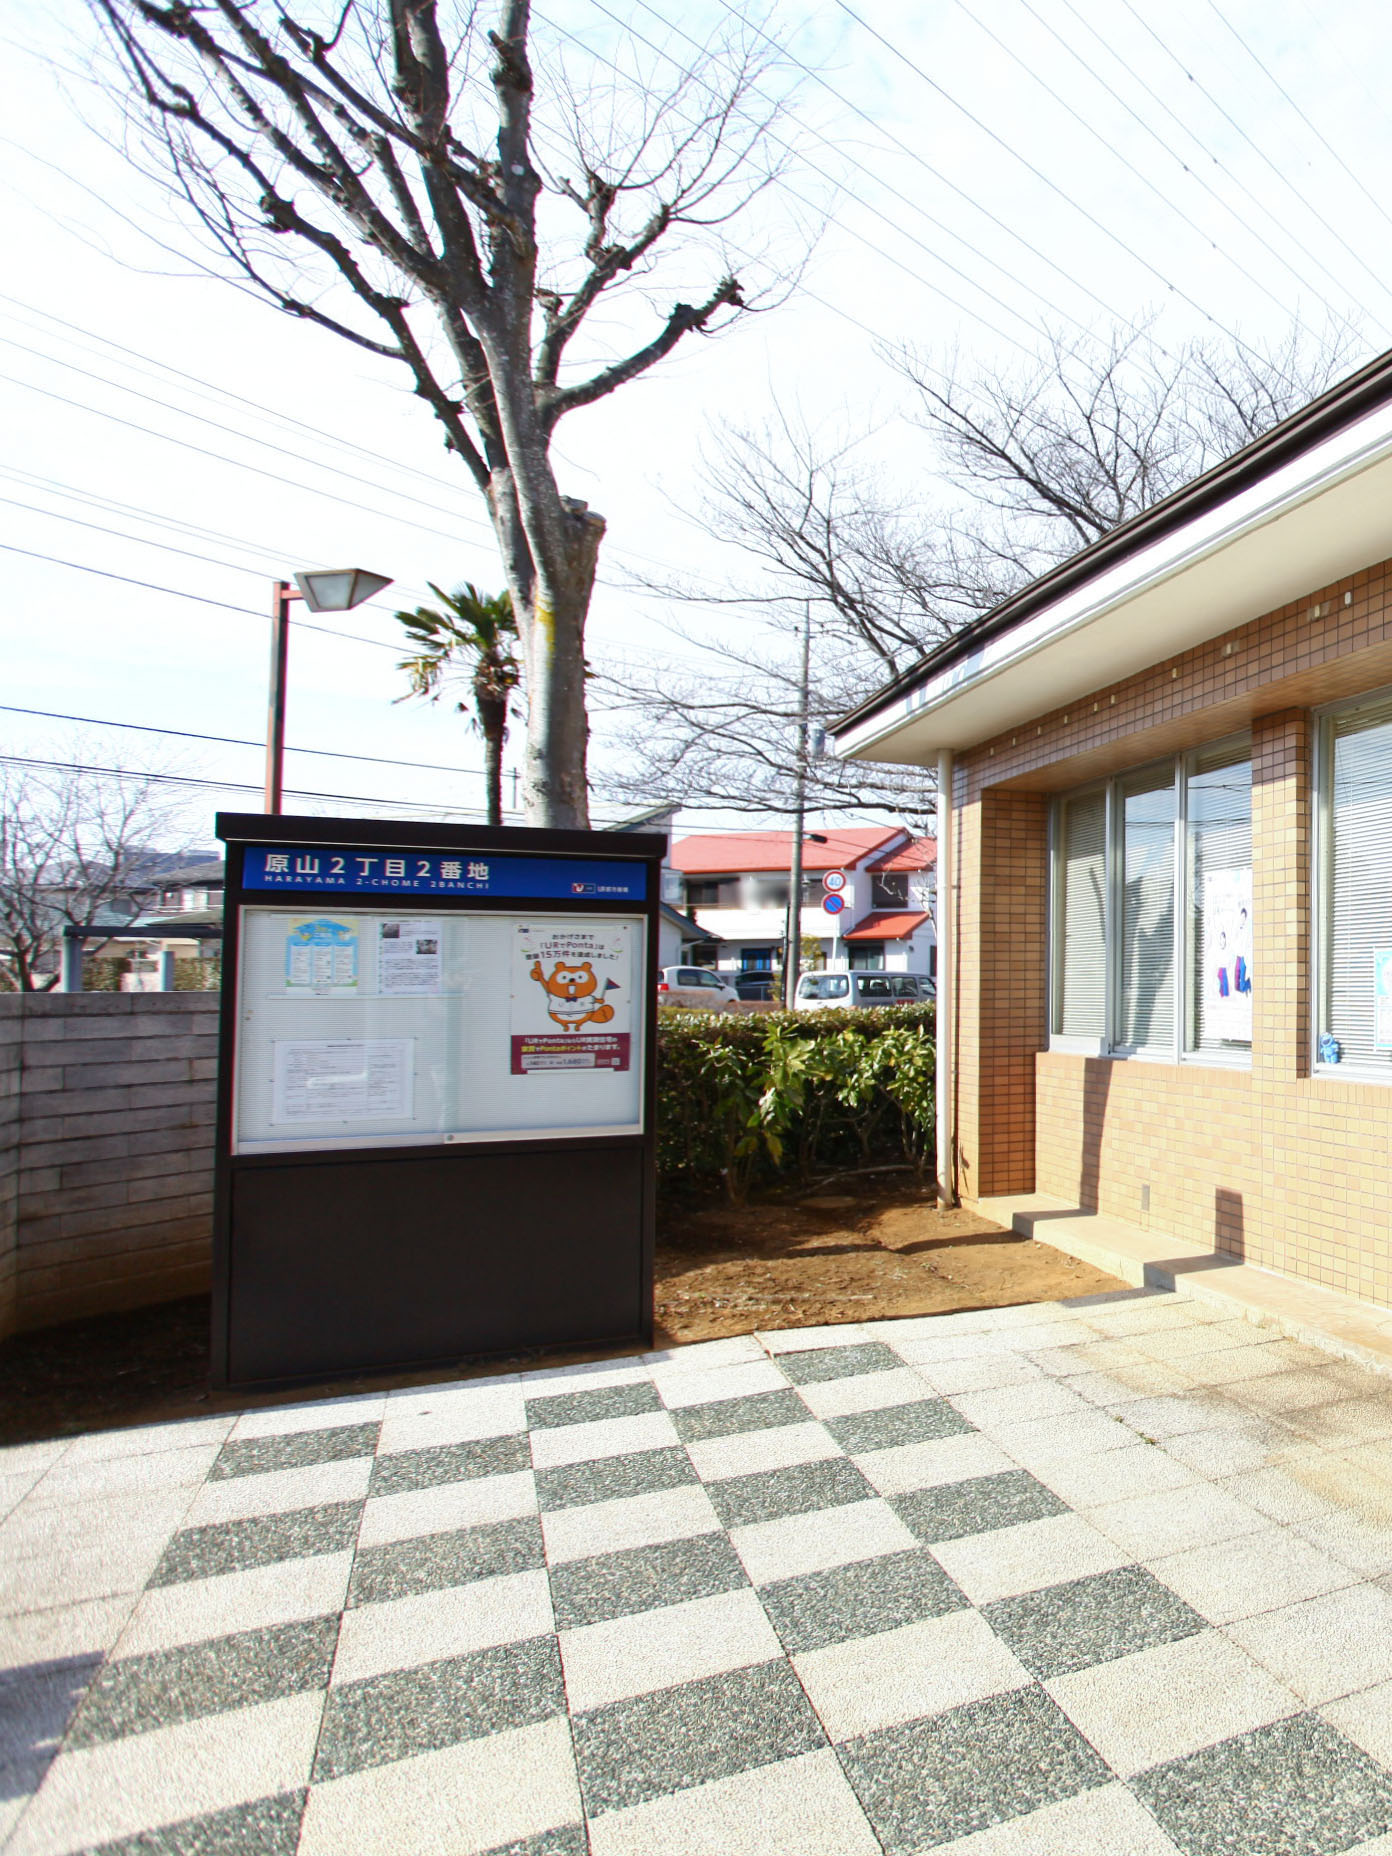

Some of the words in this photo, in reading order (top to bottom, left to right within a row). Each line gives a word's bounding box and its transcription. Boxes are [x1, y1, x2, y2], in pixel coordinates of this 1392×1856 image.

[265, 854, 489, 880] 原山2丁目2番地
[265, 875, 346, 885] HARAYAMA
[355, 878, 420, 887] 2-CHOME
[430, 881, 489, 889] 2BANCHI
[828, 876, 841, 886] 40
